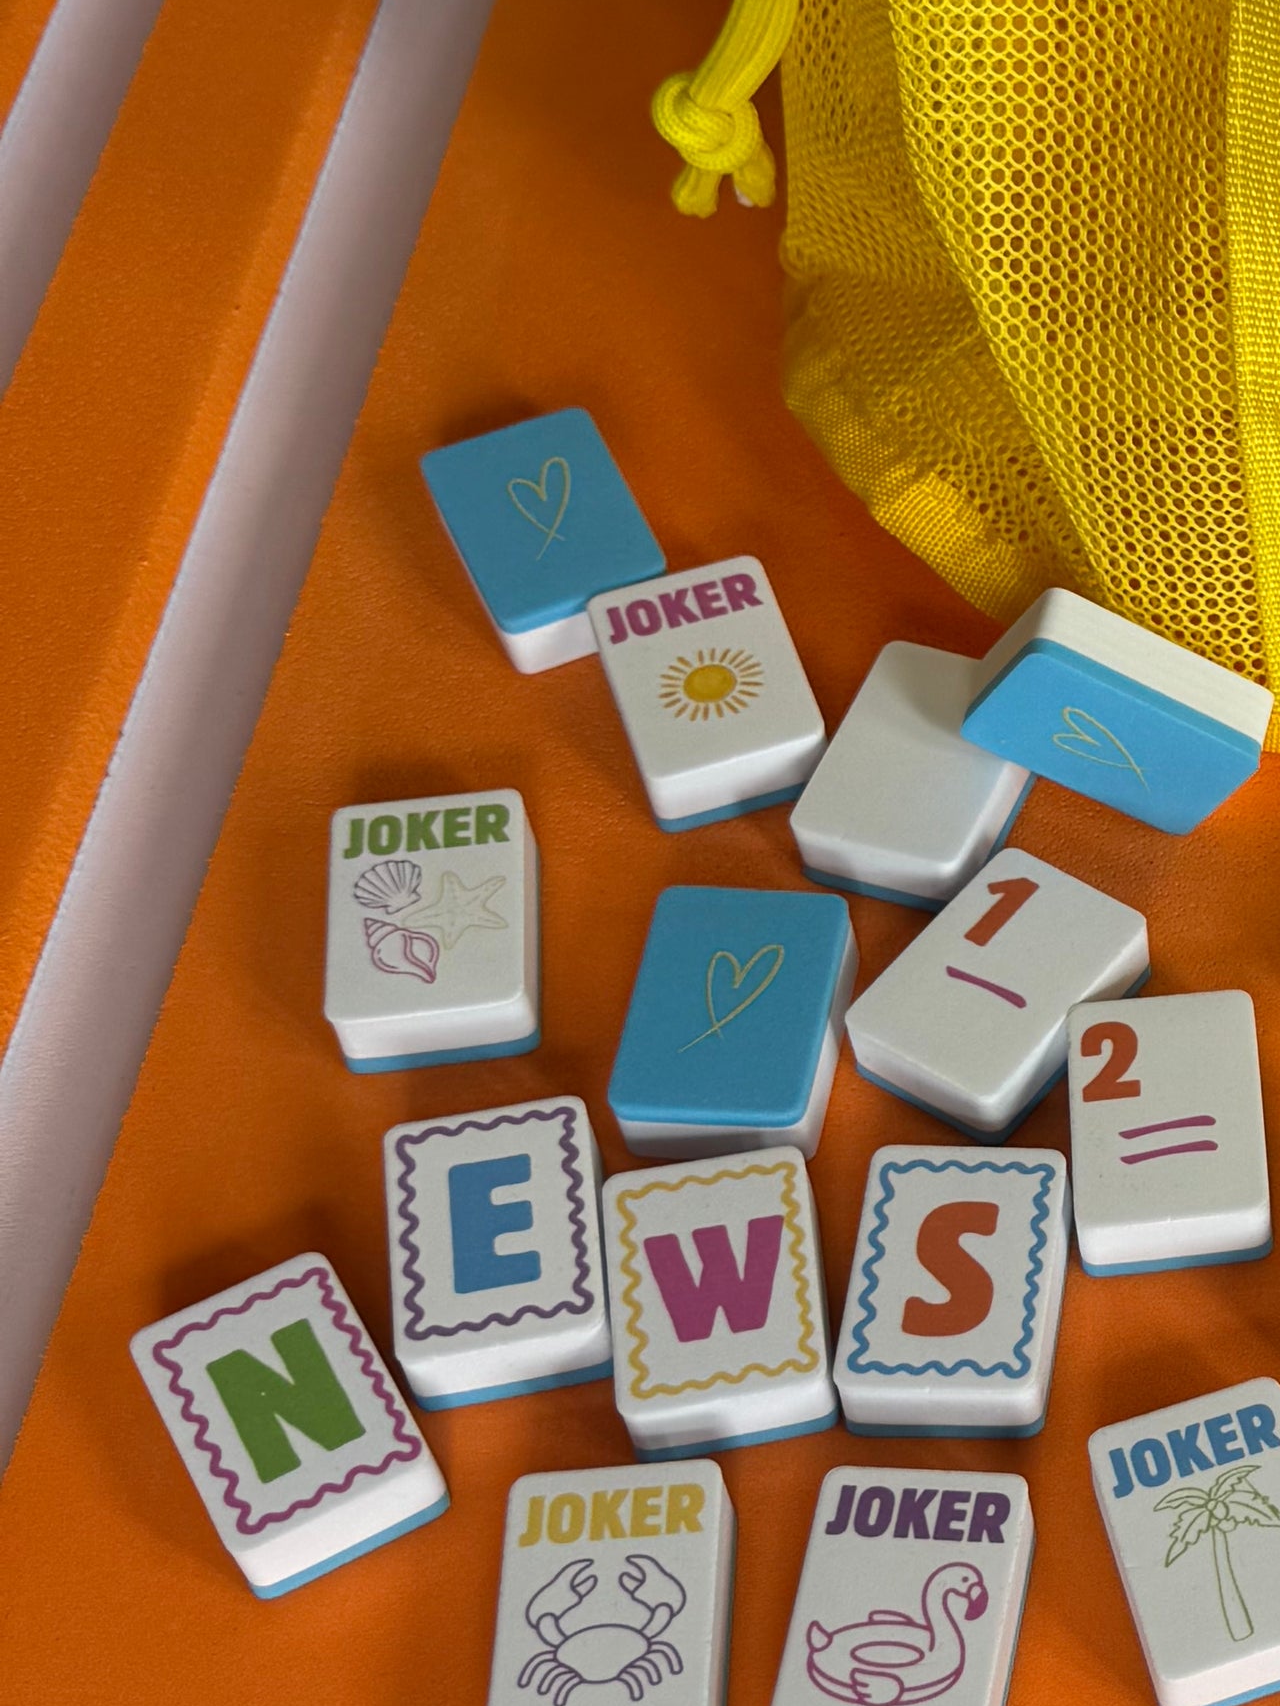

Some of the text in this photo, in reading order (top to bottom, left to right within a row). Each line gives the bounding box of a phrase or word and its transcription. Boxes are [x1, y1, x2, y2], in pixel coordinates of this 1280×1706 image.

[605, 572, 763, 644] JOKER
[341, 804, 510, 859] JOKER
[962, 875, 1041, 946] 1
[1079, 1022, 1141, 1103] 2
[448, 1154, 541, 1294] E
[644, 1215, 784, 1343] W
[902, 1201, 1000, 1338] S
[206, 1318, 366, 1484] N
[519, 1484, 706, 1546] JOKER
[826, 1485, 1012, 1544] JOKER
